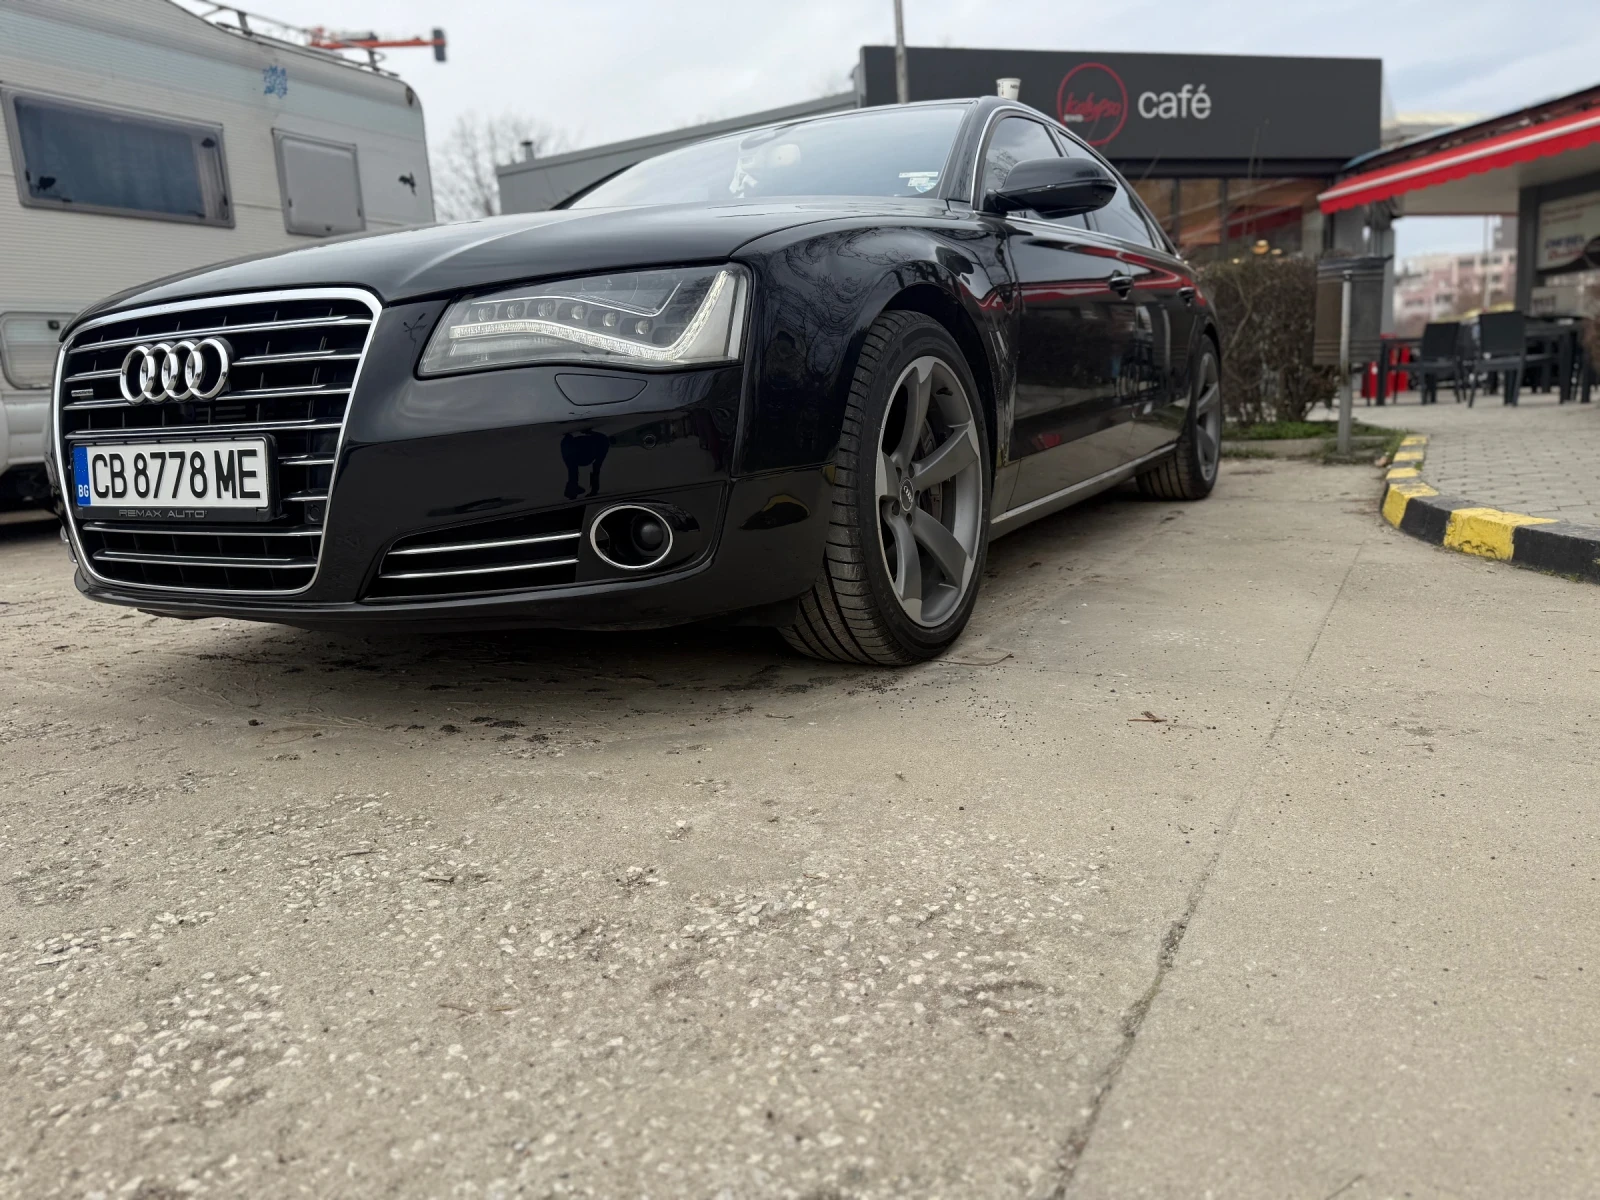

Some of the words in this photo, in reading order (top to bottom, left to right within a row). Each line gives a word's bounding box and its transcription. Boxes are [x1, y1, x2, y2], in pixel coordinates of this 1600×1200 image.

[1138, 84, 1211, 119] café
[92, 453, 128, 498] CB
[133, 450, 207, 498] 8778
[214, 449, 261, 498] ME
[78, 484, 90, 497] BG
[119, 509, 162, 518] REMAX
[167, 510, 205, 518] AUTO
